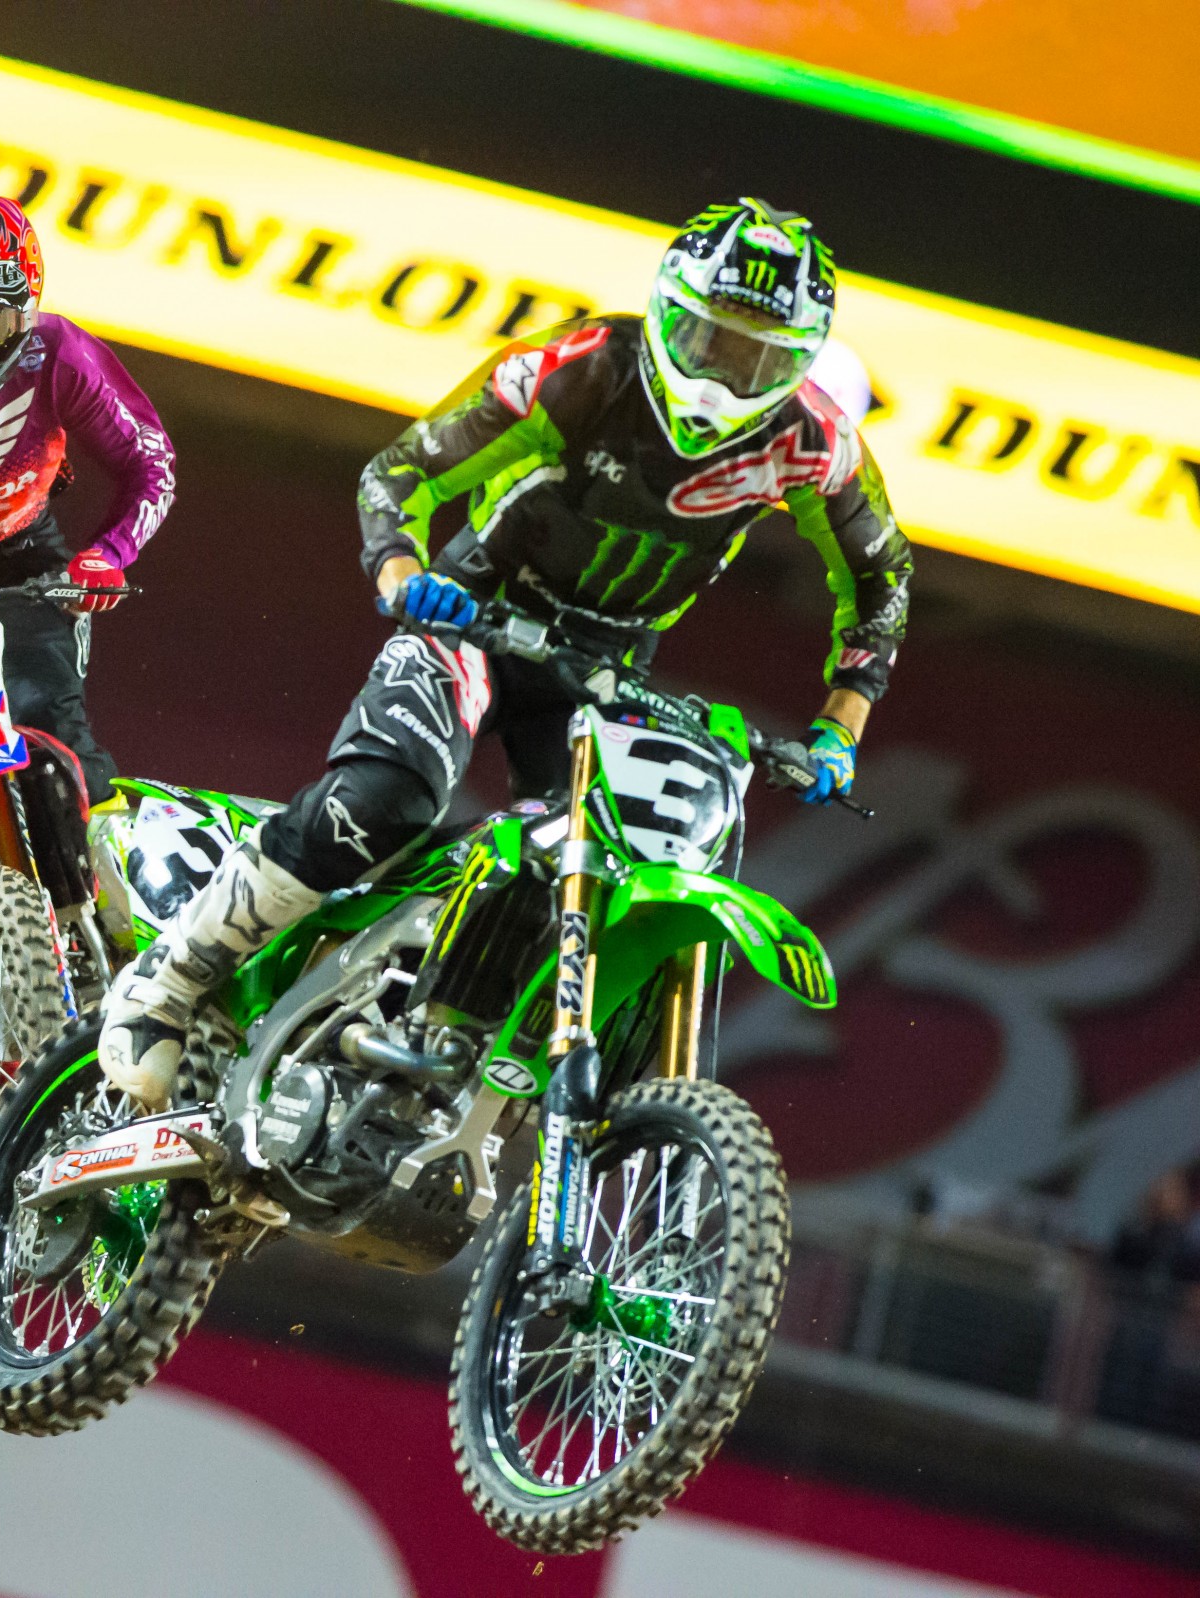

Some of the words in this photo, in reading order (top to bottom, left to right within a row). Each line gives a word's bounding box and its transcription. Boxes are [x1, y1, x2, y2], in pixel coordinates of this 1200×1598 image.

[612, 738, 729, 847] 3
[126, 827, 225, 921] 3
[51, 1143, 137, 1183] RENTHAL
[537, 1111, 569, 1247] DUNLOP
